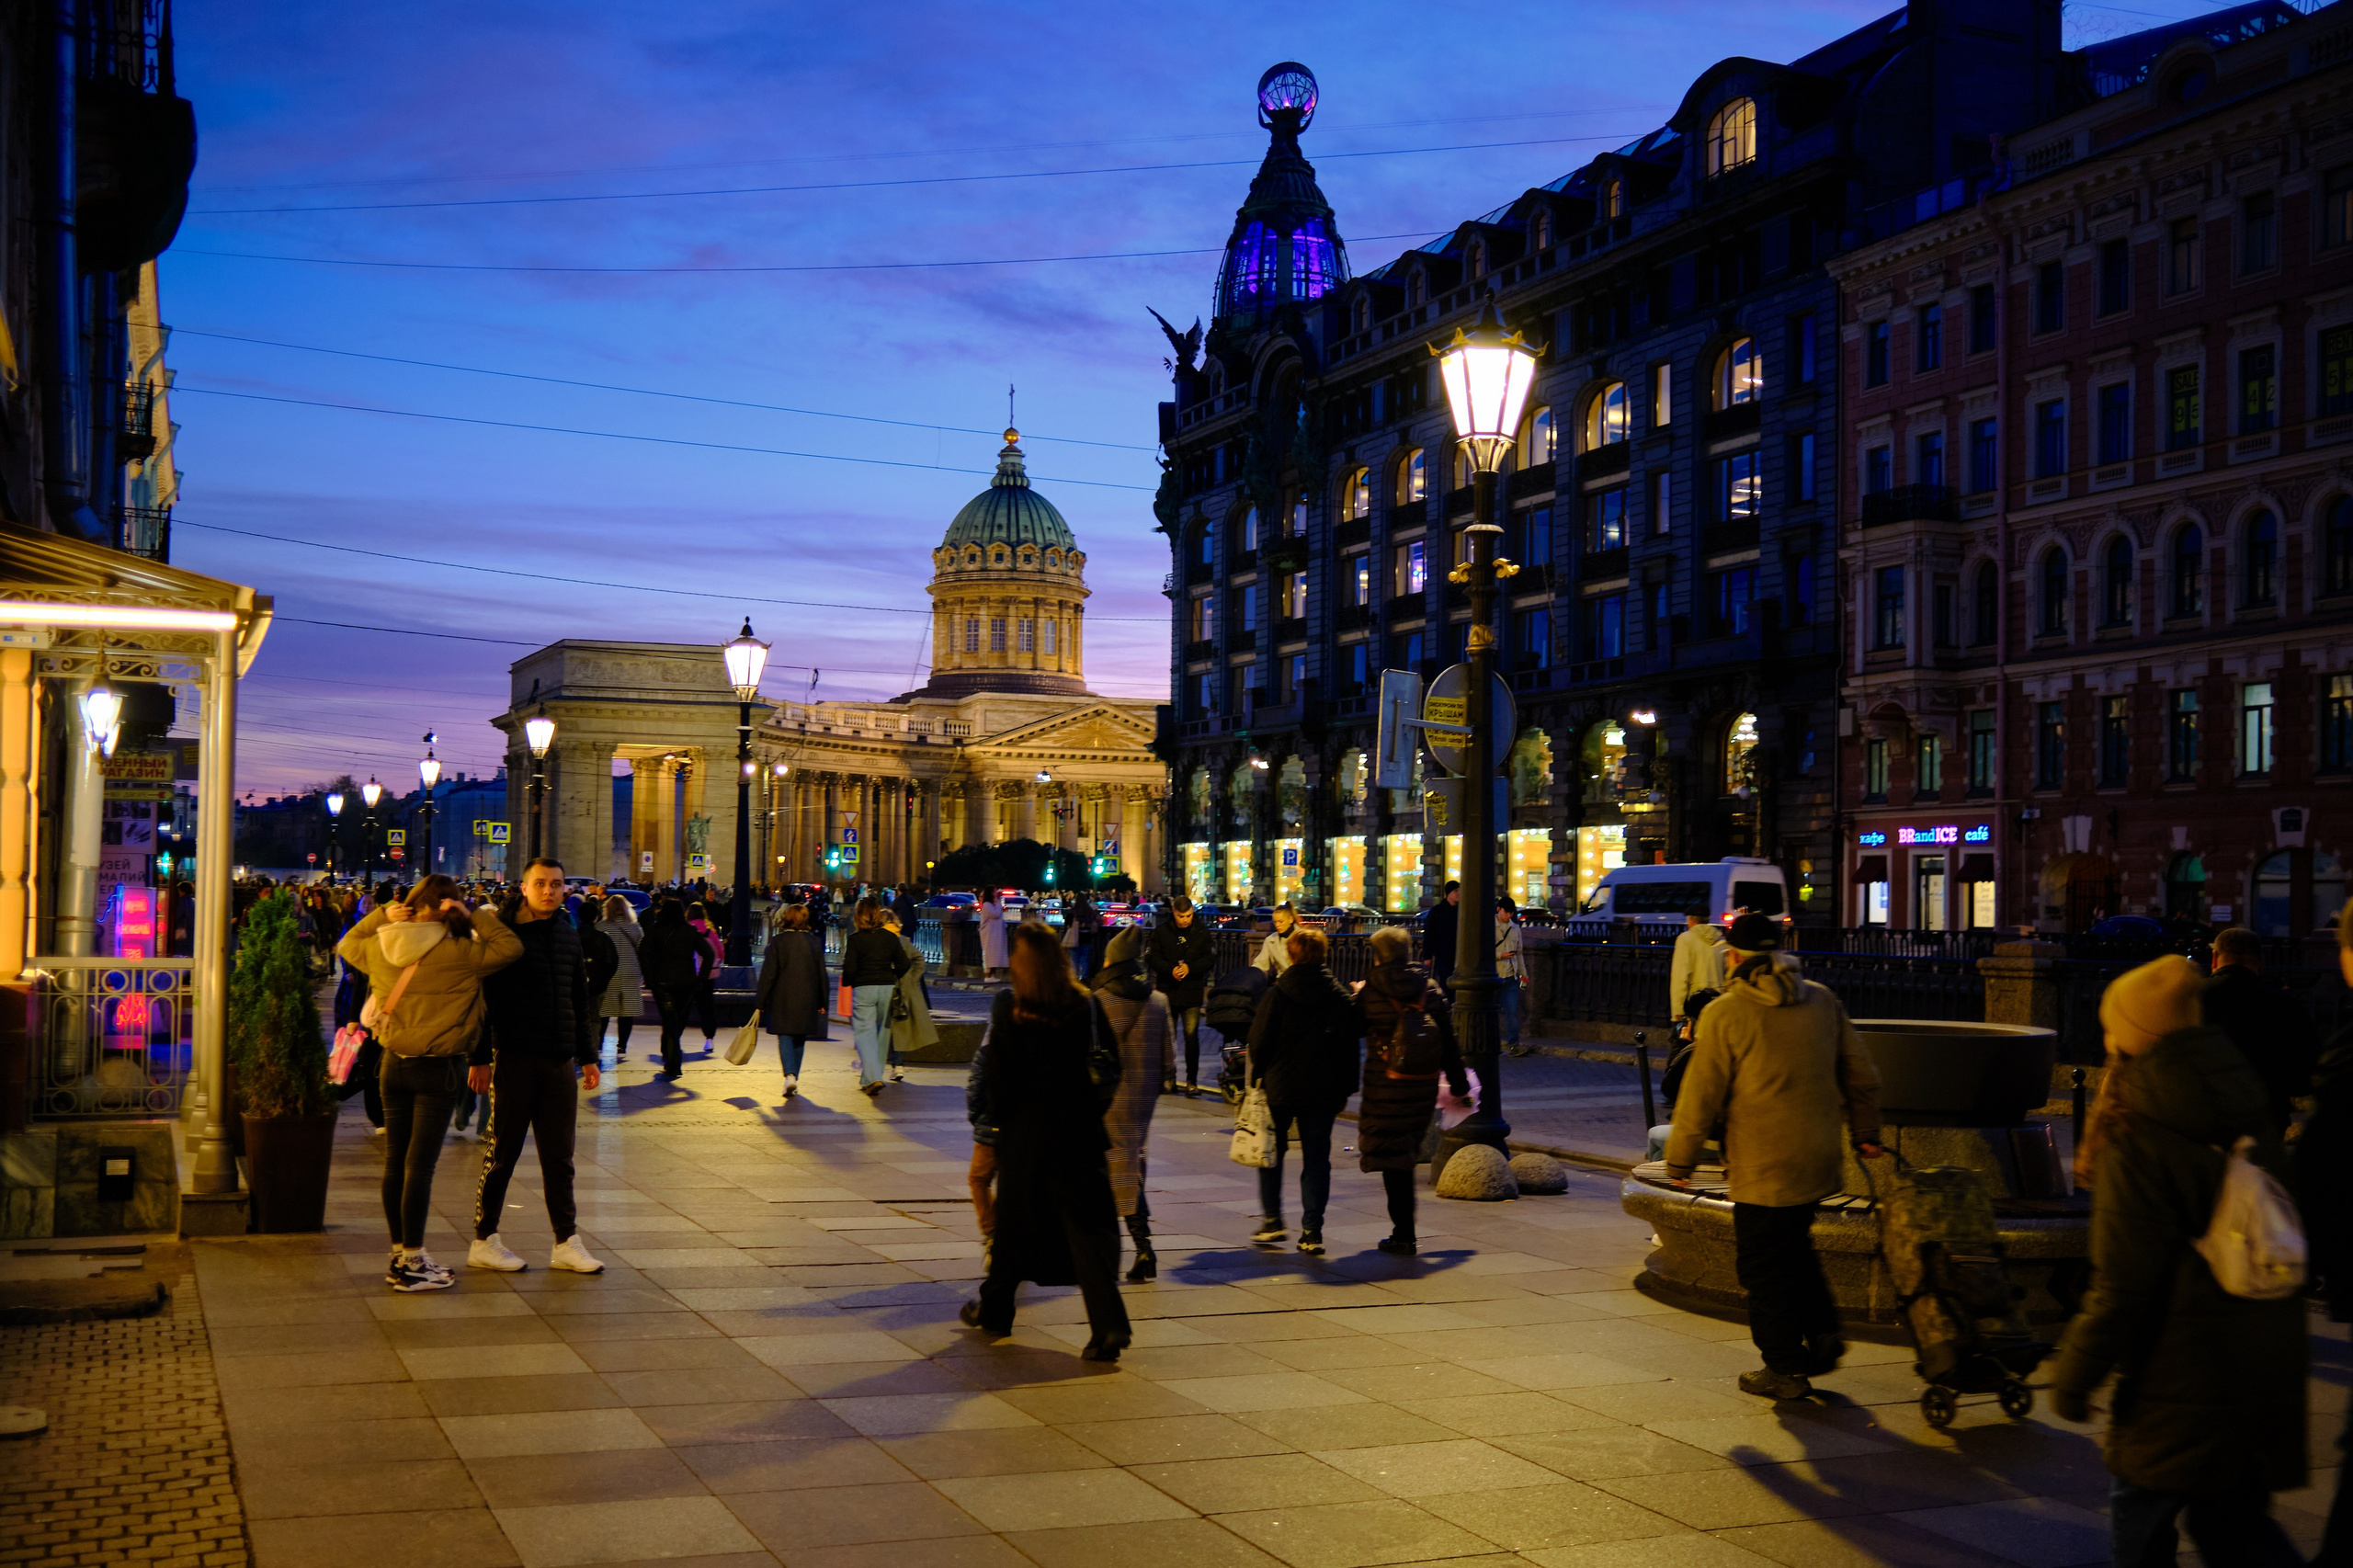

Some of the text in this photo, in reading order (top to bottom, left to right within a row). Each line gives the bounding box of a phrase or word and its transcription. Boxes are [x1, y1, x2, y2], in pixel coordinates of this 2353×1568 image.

[2176, 372, 2199, 391] SALE
[106, 757, 167, 767] ОЕННЫЙ
[1859, 832, 1886, 846] кафе
[1898, 824, 1989, 843] BRandICE café
[99, 859, 131, 869] УЗЕЙ
[1286, 850, 1296, 864] P
